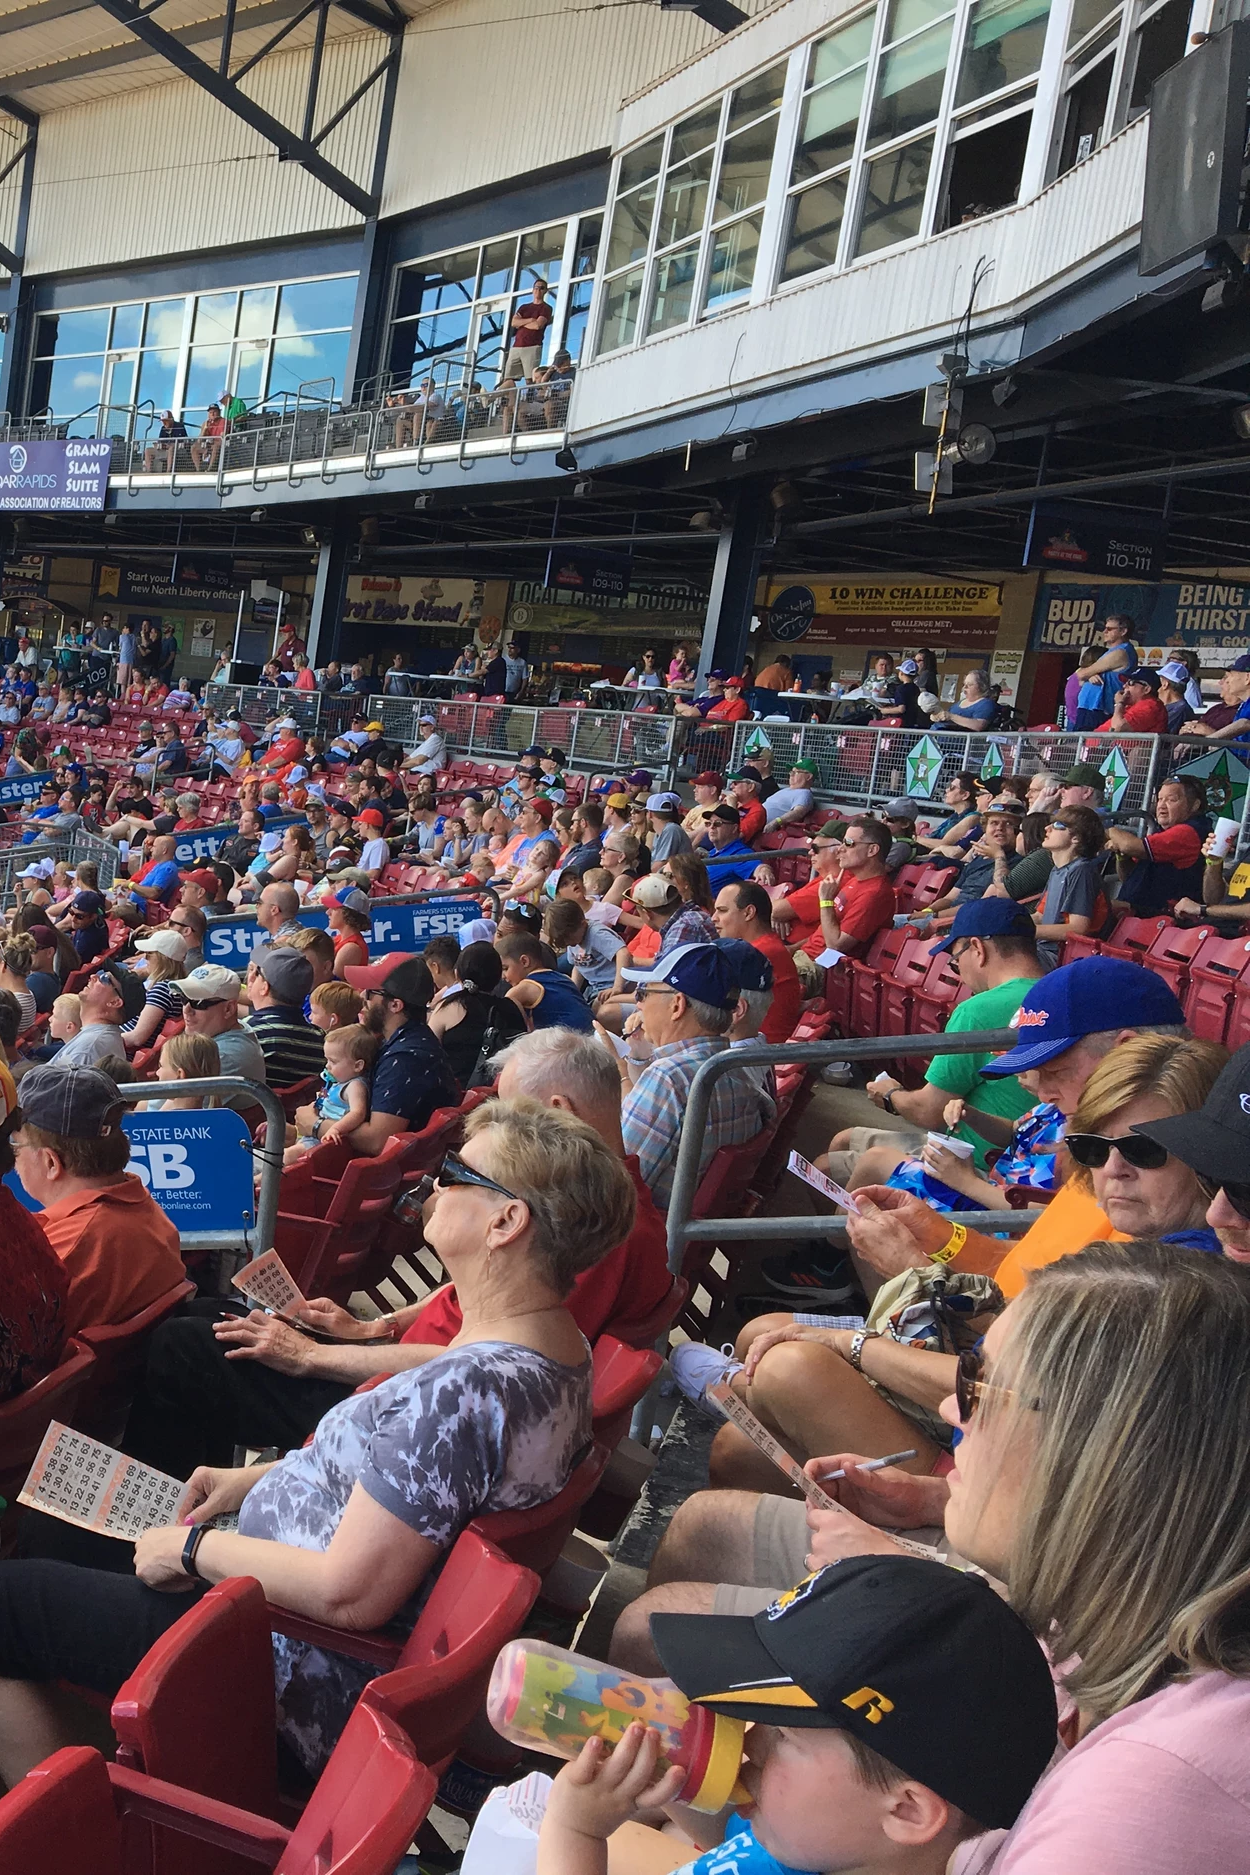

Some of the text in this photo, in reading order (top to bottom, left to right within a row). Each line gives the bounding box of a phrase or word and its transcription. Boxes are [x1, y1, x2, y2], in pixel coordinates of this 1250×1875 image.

[65, 443, 110, 457] GRAND
[68, 460, 101, 475] SLAM
[65, 478, 99, 492] SUITE
[0, 497, 49, 509] ASSOCIATION
[50, 497, 61, 509] OF
[61, 497, 103, 509] REALTORS
[1109, 540, 1153, 555] SECTION
[1106, 553, 1151, 570] 110-111
[127, 571, 170, 584] Start your
[592, 578, 624, 591] 109-110
[131, 585, 211, 600] new North Liberty
[829, 587, 989, 599] 10 WIN CHALLENGE
[1178, 585, 1244, 606] BEING
[373, 598, 410, 621] Base
[412, 599, 463, 622] Stand
[1048, 600, 1095, 622] BUD
[891, 620, 934, 628] CHALLENGE
[87, 667, 107, 684] 109
[412, 908, 440, 916] FARMERS
[413, 913, 465, 936] FSB
[133, 1128, 171, 1140] STATE
[174, 1127, 212, 1139] BANK
[38, 1432, 69, 1493] 4 26 38 52 71
[48, 1437, 80, 1500] 11 30 43 51 74
[59, 1442, 91, 1505] 5 27 55 63
[70, 1448, 102, 1511] 13 22 33 56 75
[80, 1453, 113, 1517] 14 29 41 59 64
[104, 1464, 137, 1529] 14 19 35 55 69
[120, 1510, 131, 1523] 21
[126, 1496, 136, 1509] 45
[132, 1483, 142, 1496] 54
[148, 1507, 159, 1520] 43
[154, 1494, 164, 1506] 49
[159, 1480, 170, 1493] 68
[159, 1486, 182, 1525] 31 50 62
[127, 1476, 159, 1538] 13 25 52 61
